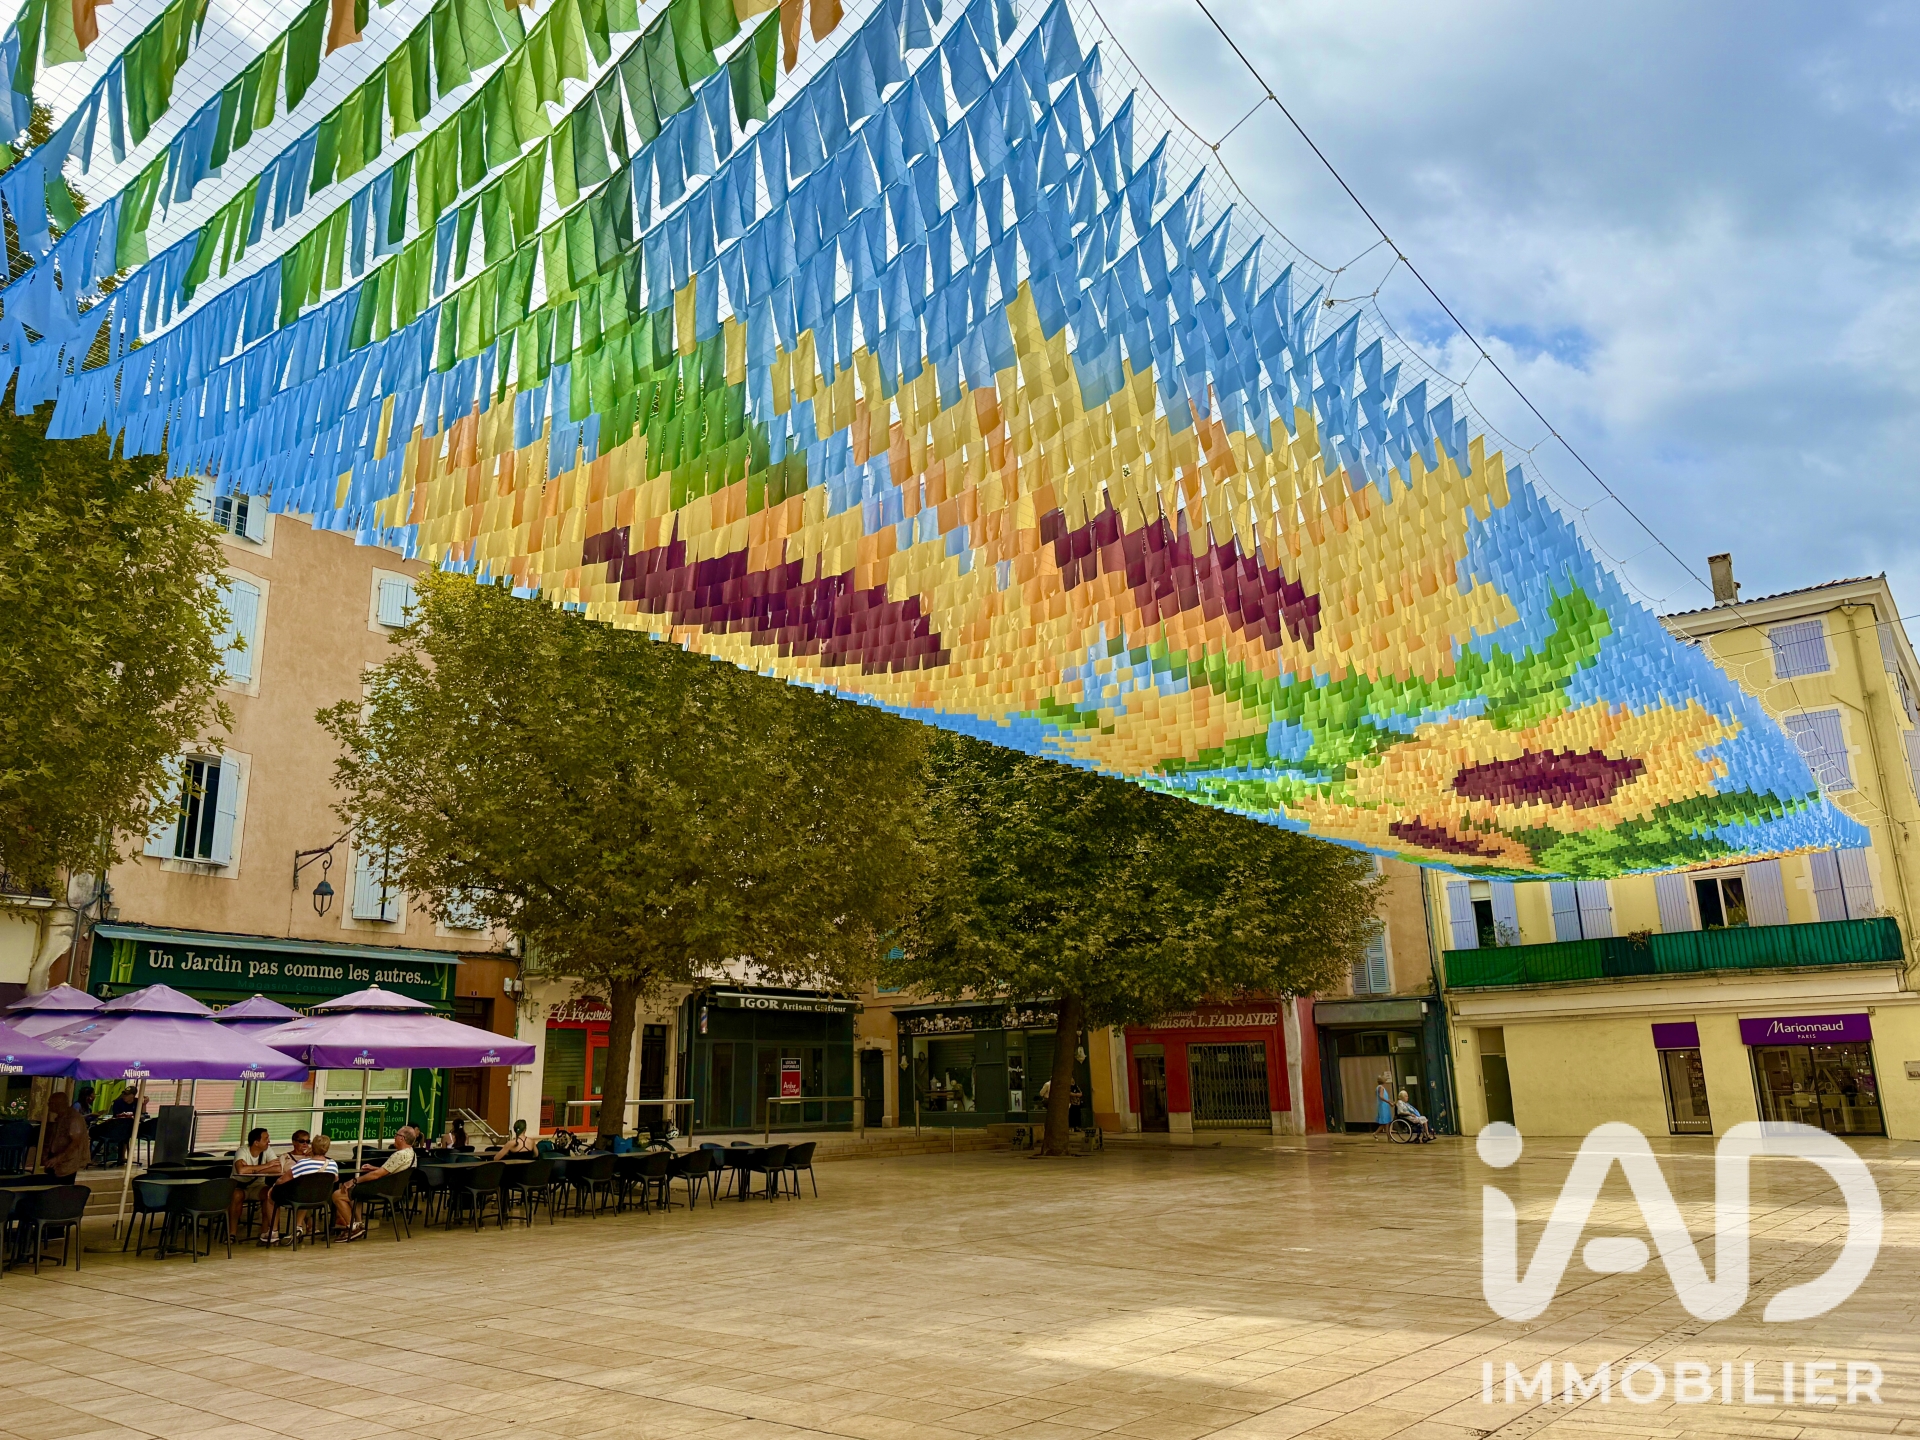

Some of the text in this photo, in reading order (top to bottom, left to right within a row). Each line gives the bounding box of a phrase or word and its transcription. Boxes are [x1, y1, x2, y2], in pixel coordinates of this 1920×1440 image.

[149, 949, 431, 985] Un Jardin pas comme les autres...
[237, 980, 343, 994] Magasin Conseils
[740, 997, 847, 1013] IGOR Artisan Ciffeur
[1150, 1016, 1196, 1029] maison
[1766, 1019, 1844, 1037] Marionnaud
[0, 1062, 24, 1073] ffligem
[393, 1101, 405, 1113] 61
[330, 1127, 377, 1139] Prodits
